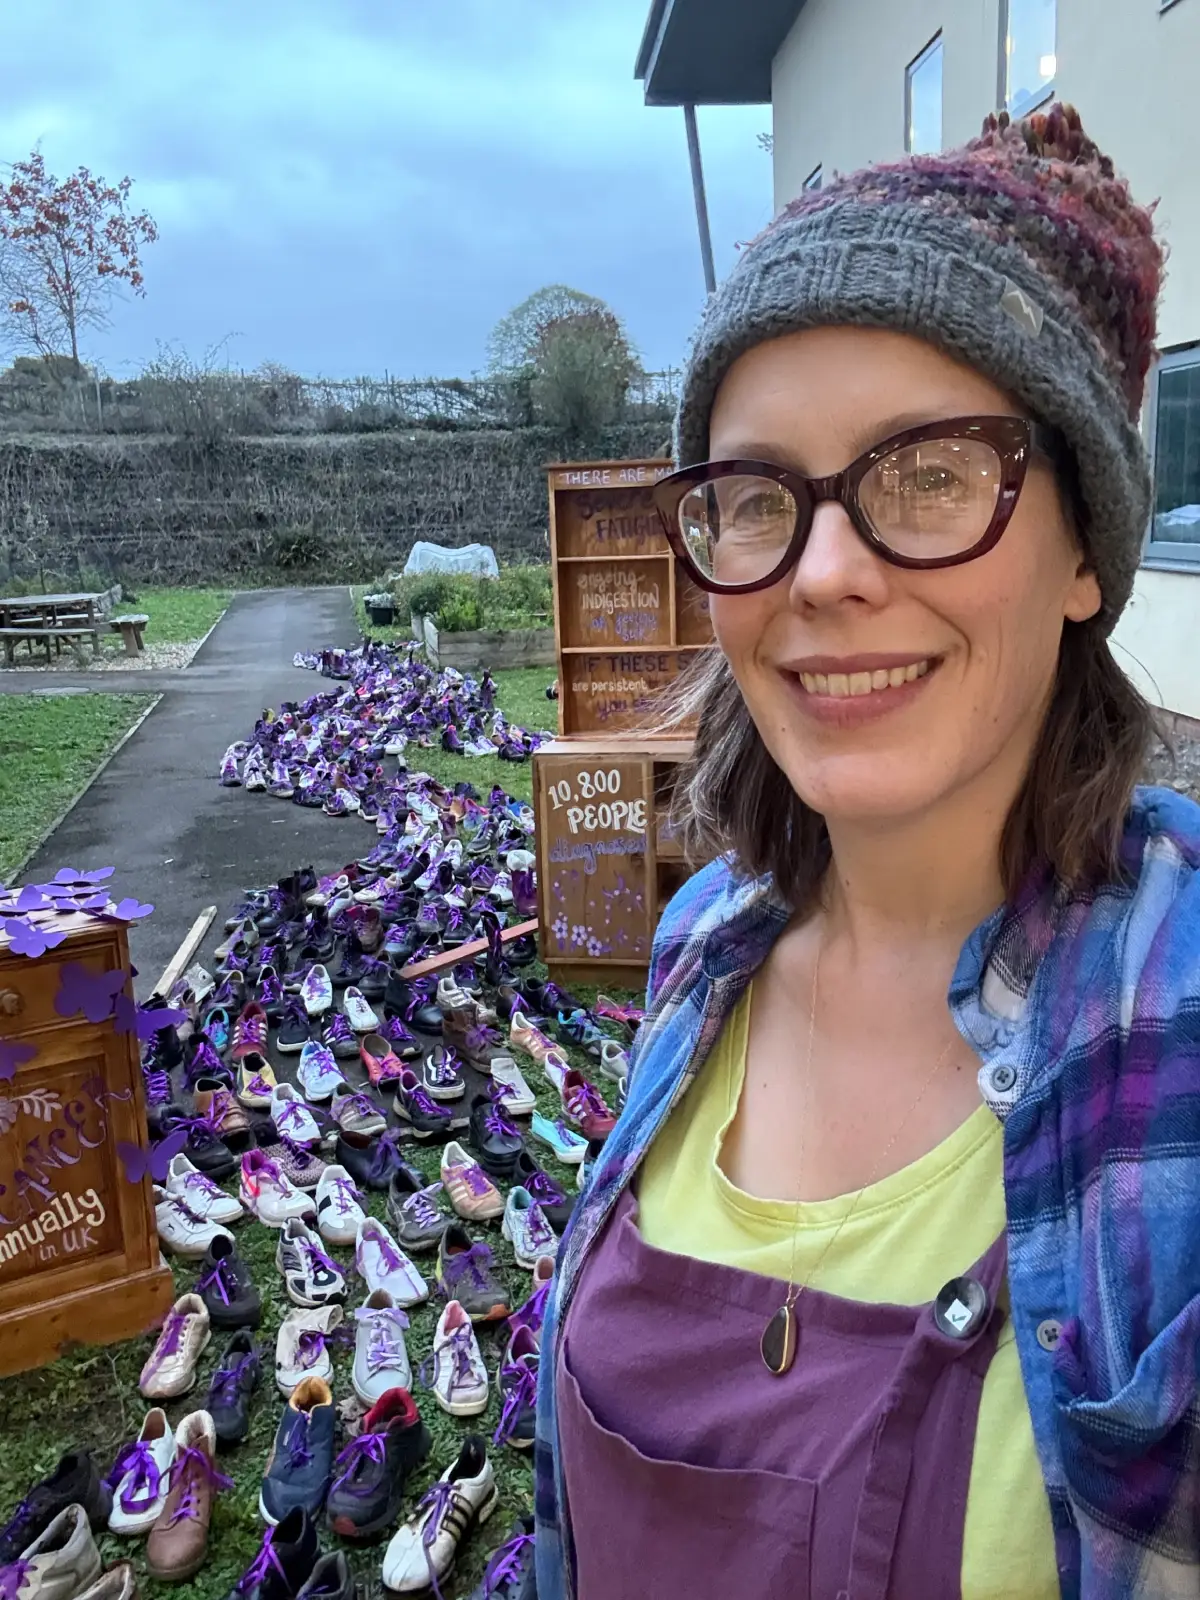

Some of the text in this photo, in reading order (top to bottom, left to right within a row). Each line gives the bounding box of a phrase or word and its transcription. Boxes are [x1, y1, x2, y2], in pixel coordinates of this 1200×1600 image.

[559, 469, 611, 485] THERE
[619, 467, 646, 482] ARE
[582, 583, 660, 614] INDIGESTION
[606, 655, 669, 673] THESE
[572, 681, 589, 692] are
[548, 769, 621, 810] 10,800
[566, 799, 648, 834] PEOPLE
[550, 834, 647, 875] diagnosed
[0, 1188, 106, 1268] nnually
[39, 1226, 99, 1261] in UK
